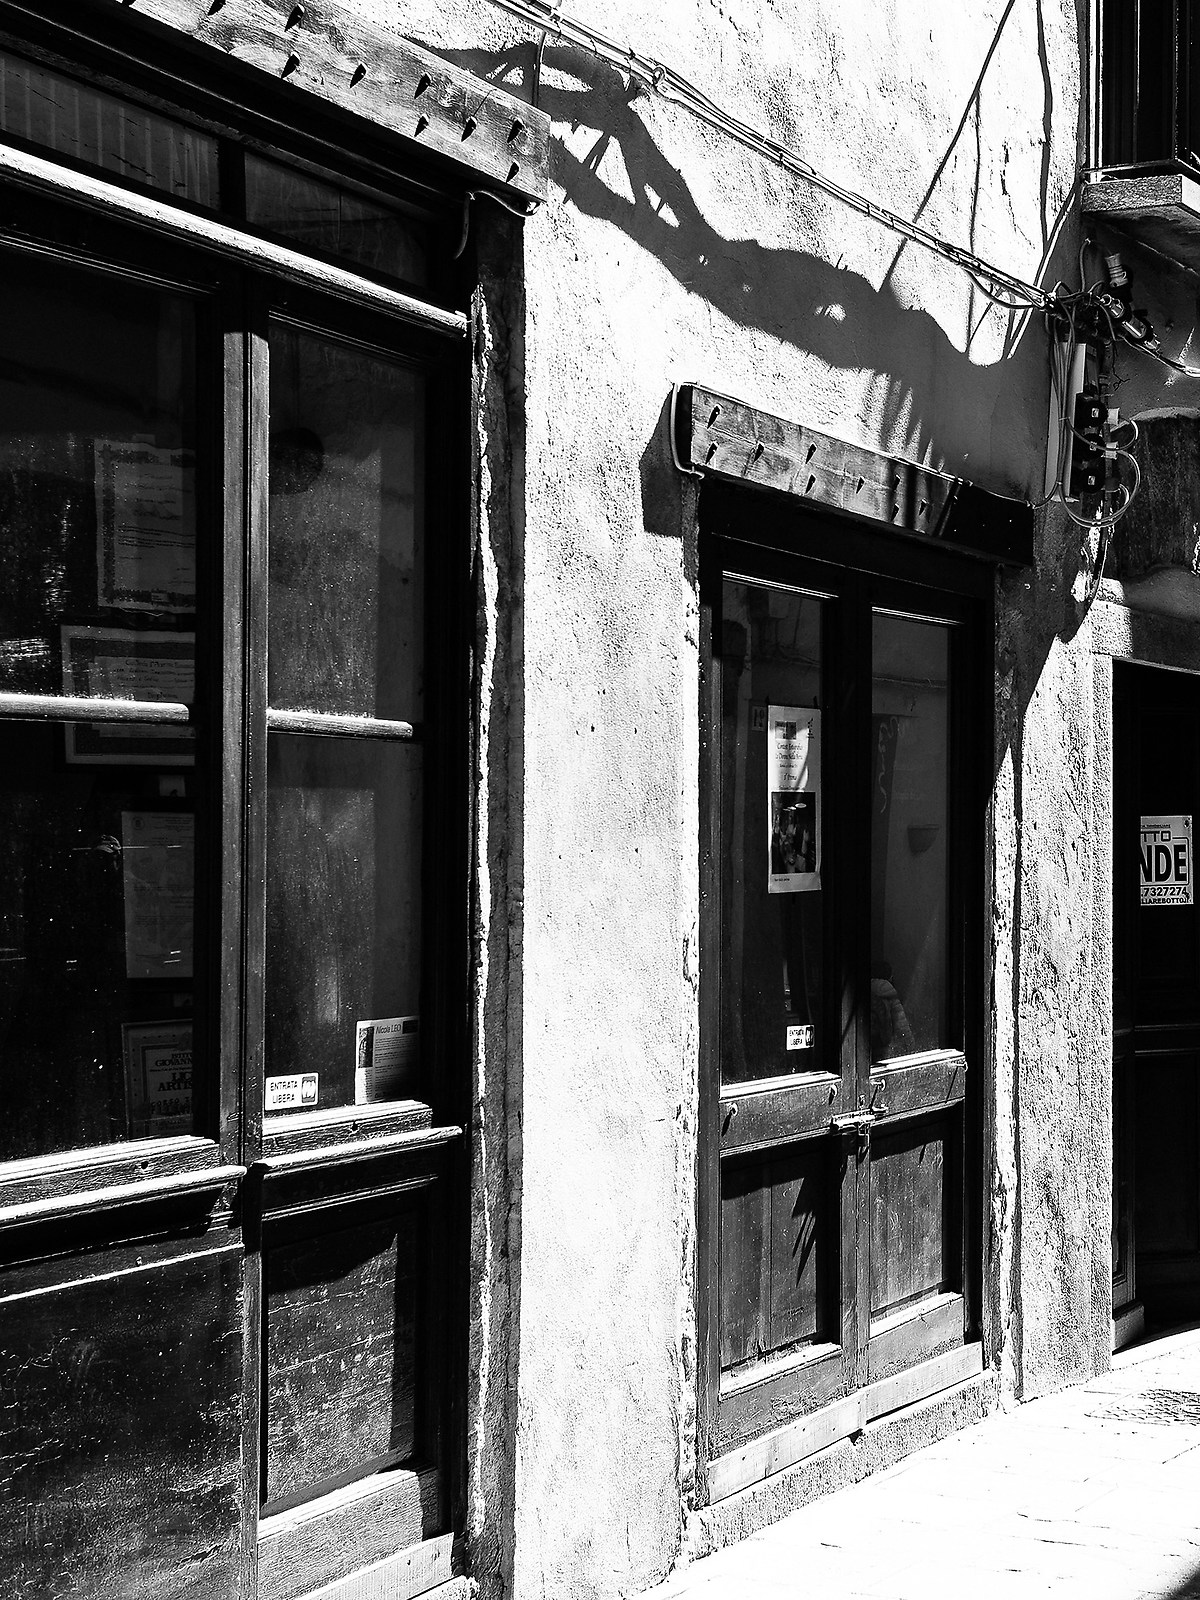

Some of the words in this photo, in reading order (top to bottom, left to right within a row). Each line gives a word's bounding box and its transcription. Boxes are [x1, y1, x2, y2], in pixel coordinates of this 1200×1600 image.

[1140, 844, 1188, 882] NDE
[270, 1080, 298, 1091] ENTRATA
[272, 1093, 295, 1104] LIBERA
